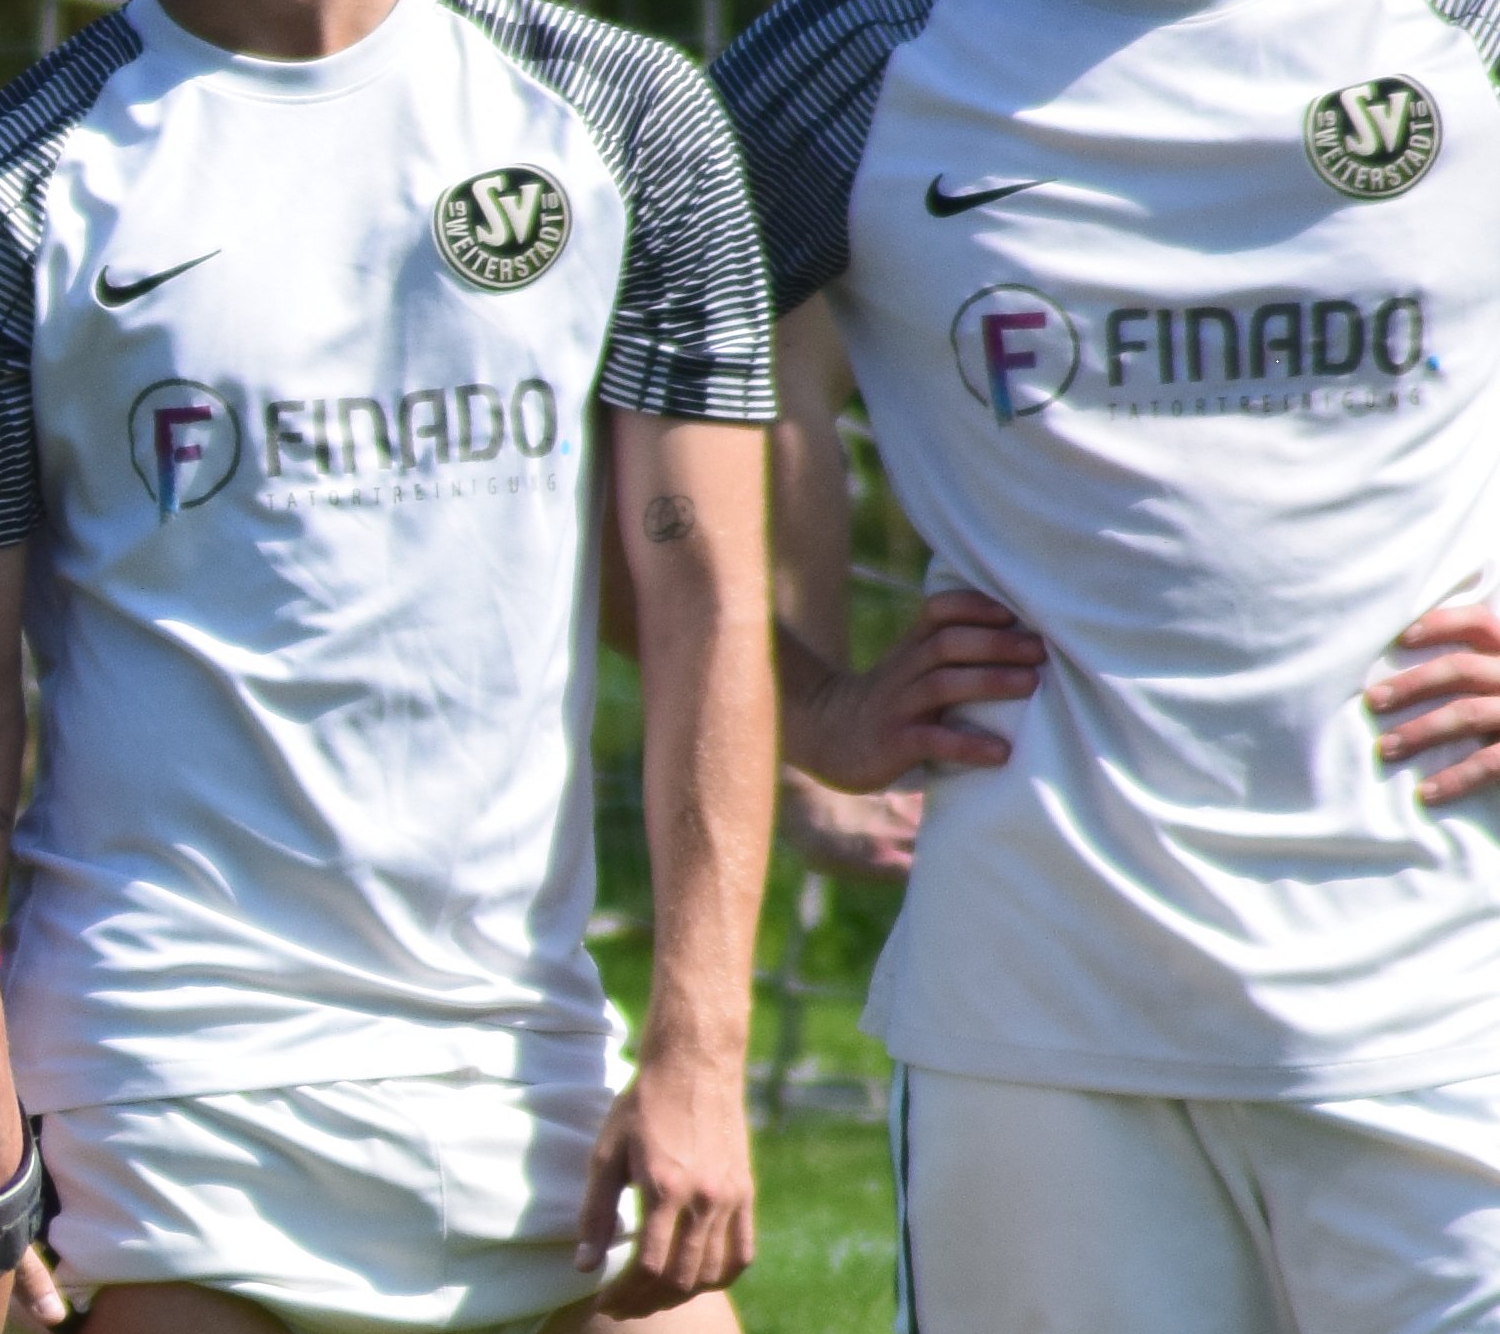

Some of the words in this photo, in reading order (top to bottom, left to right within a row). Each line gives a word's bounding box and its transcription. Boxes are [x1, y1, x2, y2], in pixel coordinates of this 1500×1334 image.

[1340, 84, 1409, 156] SV
[1314, 121, 1433, 190] WEITERSTADT
[471, 174, 542, 247] SV
[445, 212, 564, 281] WEITERSTADT
